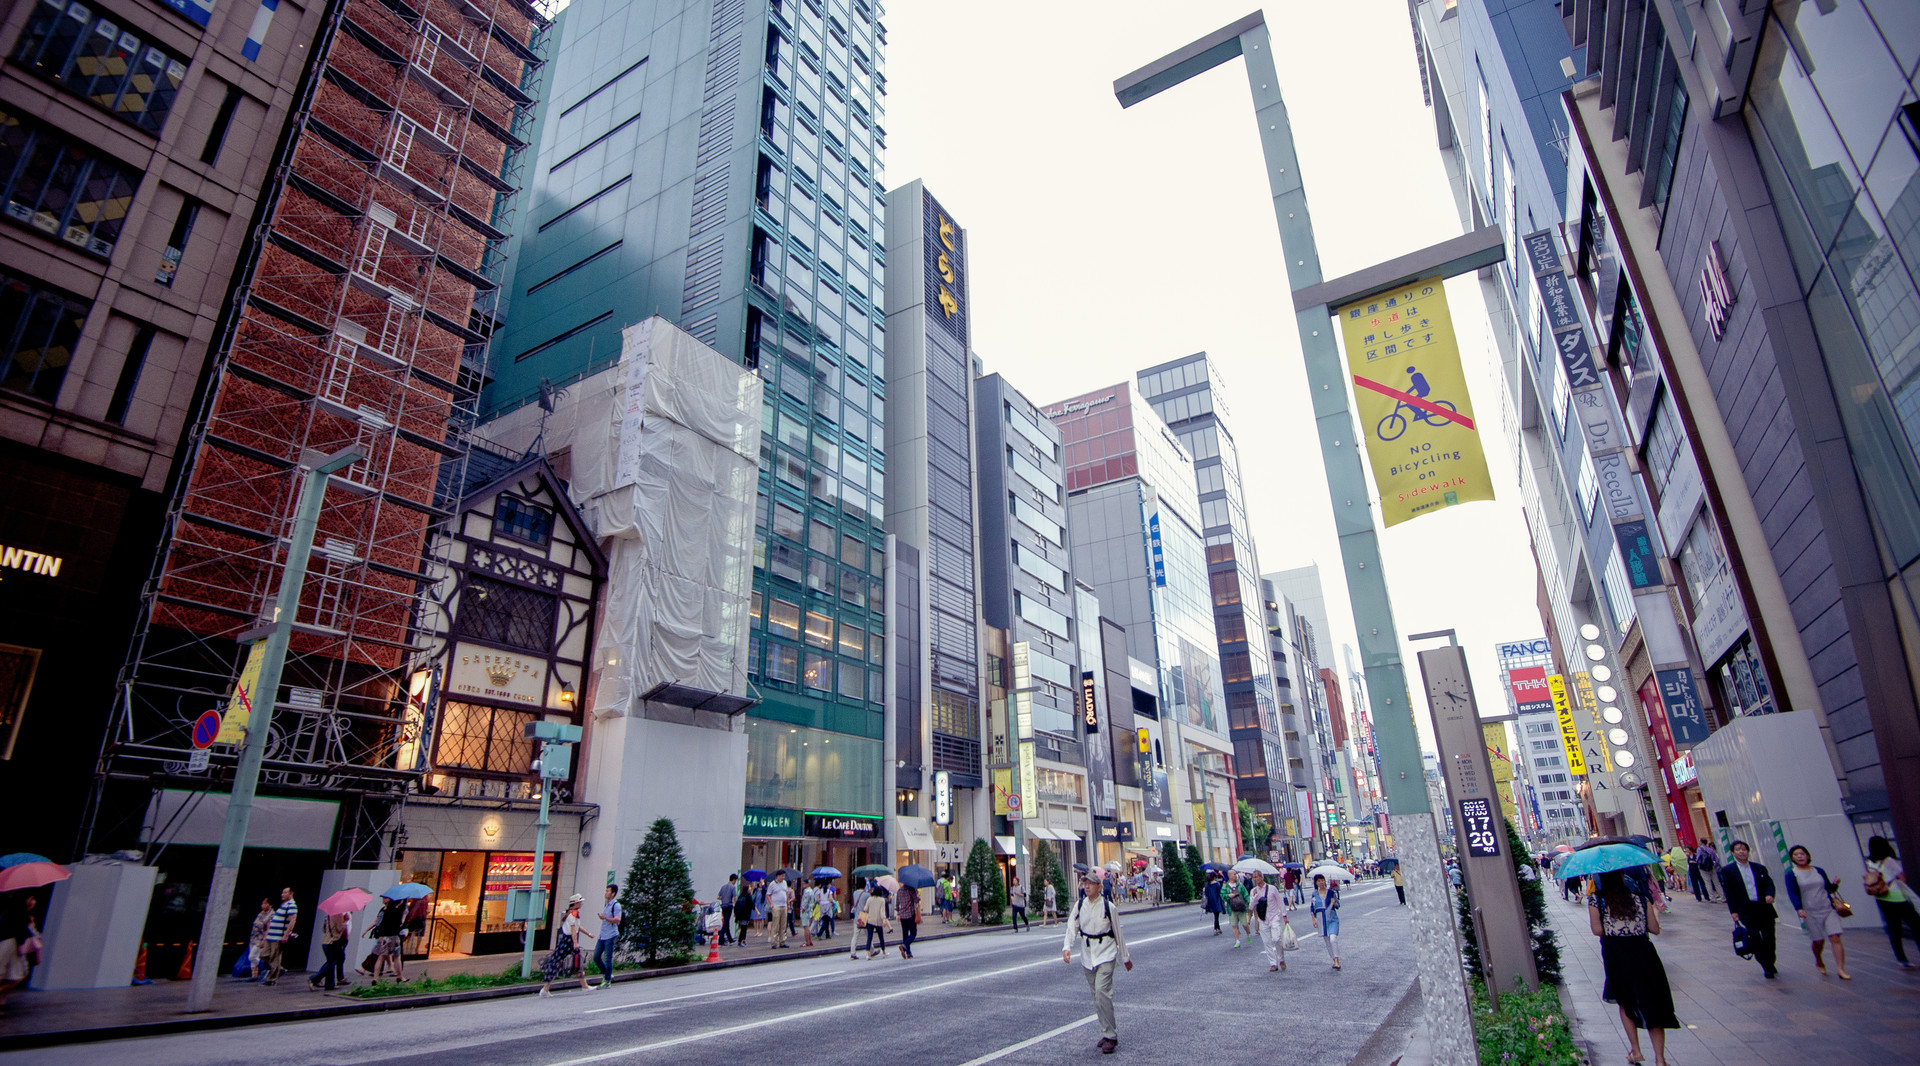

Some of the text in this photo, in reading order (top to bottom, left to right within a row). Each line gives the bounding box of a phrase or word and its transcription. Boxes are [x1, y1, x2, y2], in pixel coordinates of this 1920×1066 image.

[937, 213, 958, 319] とらや
[1349, 286, 1433, 319] 銀座通りの
[1370, 306, 1418, 327] 歩道は
[1364, 318, 1430, 345] 押し歩き
[1366, 333, 1433, 361] 区間です
[1560, 330, 1596, 386] ダンス
[1410, 442, 1432, 455] NO
[1390, 450, 1461, 476] Bicycling
[1419, 470, 1436, 480] on
[1588, 420, 1635, 518] Dr. Recella
[1398, 477, 1466, 502] Sidewalk
[0, 544, 63, 578] NTIN
[1501, 639, 1552, 659] FANCL
[1512, 678, 1548, 691] THK
[1665, 682, 1690, 740] シロー
[1552, 690, 1583, 768] ライオンビヤホール
[1581, 730, 1609, 791] ZARA
[760, 816, 791, 828] GREEN
[1467, 816, 1491, 831] 17
[1469, 831, 1495, 848] 20
